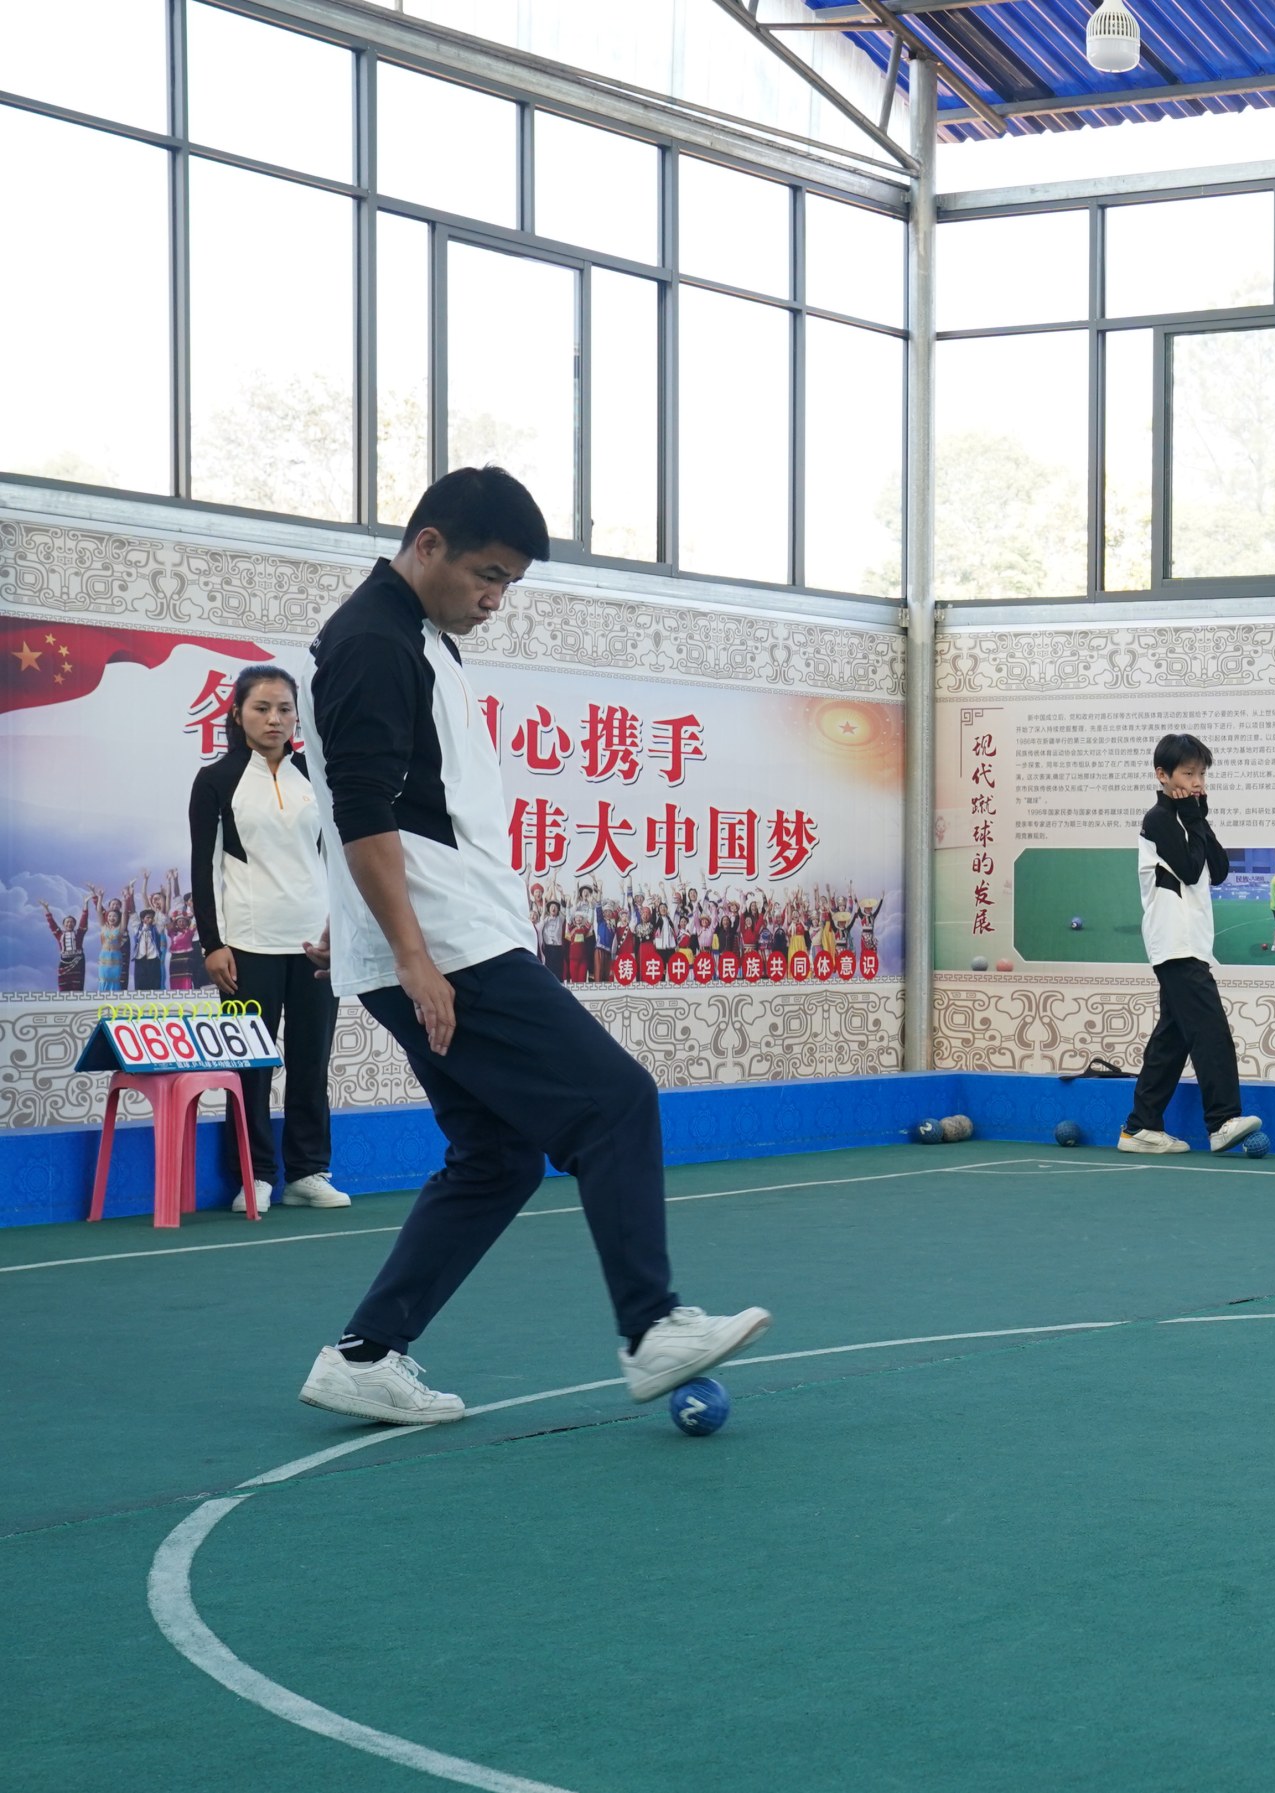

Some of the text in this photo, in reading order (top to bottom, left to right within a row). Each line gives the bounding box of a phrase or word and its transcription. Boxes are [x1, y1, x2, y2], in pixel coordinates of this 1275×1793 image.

[478, 695, 705, 784] 心携手
[508, 797, 818, 880] 伟大中国梦
[971, 733, 997, 935] 现代蹴球的发展
[617, 956, 876, 980] 铸牢中华民族共同体意识
[113, 1020, 270, 1062] 068 061
